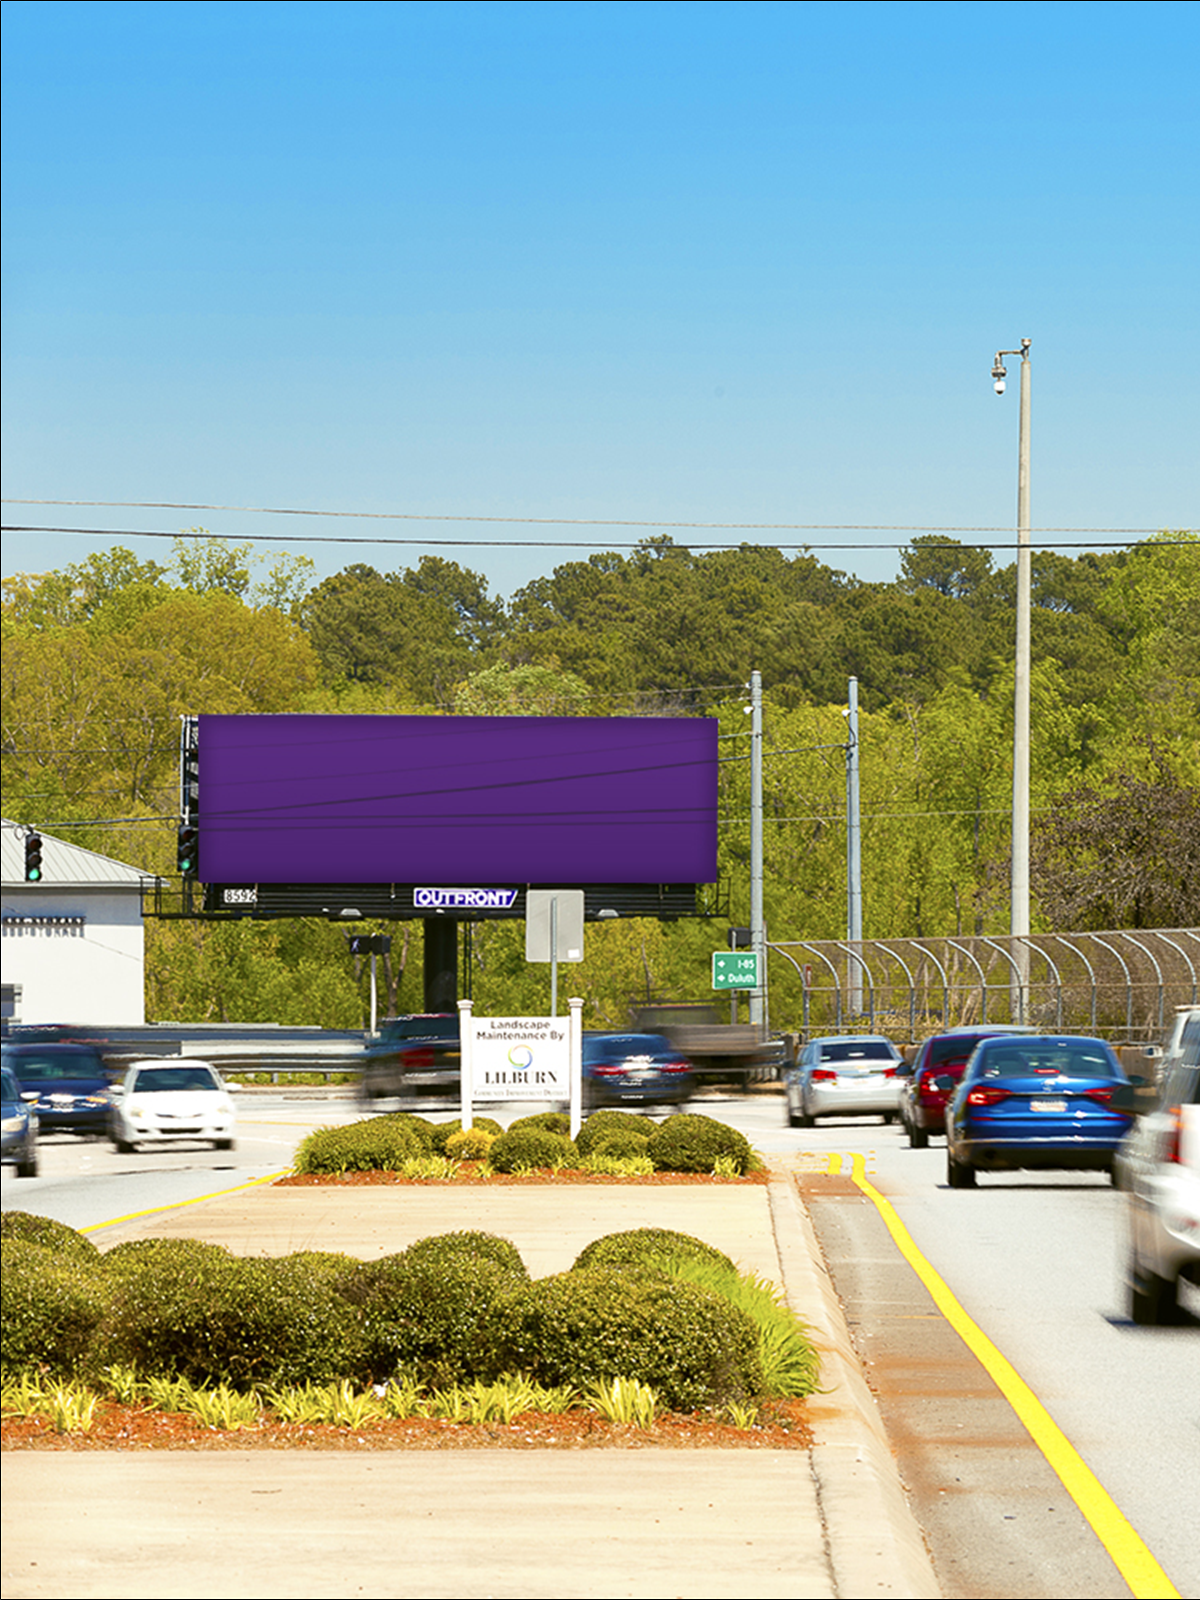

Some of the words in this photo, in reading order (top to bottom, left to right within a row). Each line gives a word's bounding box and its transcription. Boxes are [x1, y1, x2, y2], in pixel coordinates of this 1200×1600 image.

[225, 890, 257, 902] 8592
[418, 890, 512, 906] OUTFRONT
[728, 973, 755, 983] Duluth
[490, 1020, 551, 1030] Landscape
[476, 1031, 547, 1040] Maintenance
[549, 1030, 565, 1041] By
[485, 1071, 558, 1084] LILBURN
